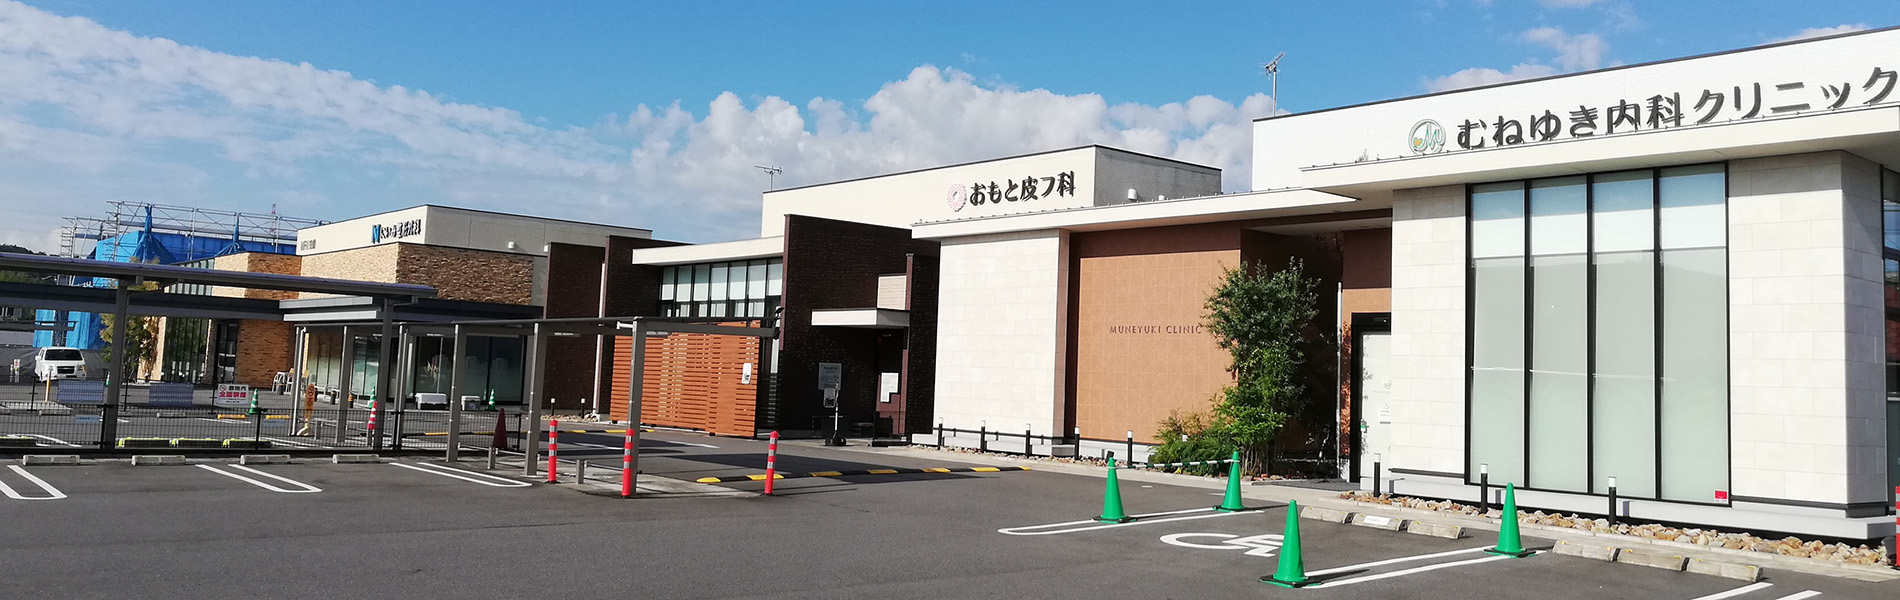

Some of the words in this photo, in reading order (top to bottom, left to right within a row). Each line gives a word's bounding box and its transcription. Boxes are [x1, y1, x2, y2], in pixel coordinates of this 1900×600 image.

[1457, 66, 1898, 149] むねゆき内科クリニック
[970, 170, 1076, 206] おもと皮フ科
[1110, 325, 1161, 334] MUNEYUKI
[1166, 325, 1202, 334] CLINIC
